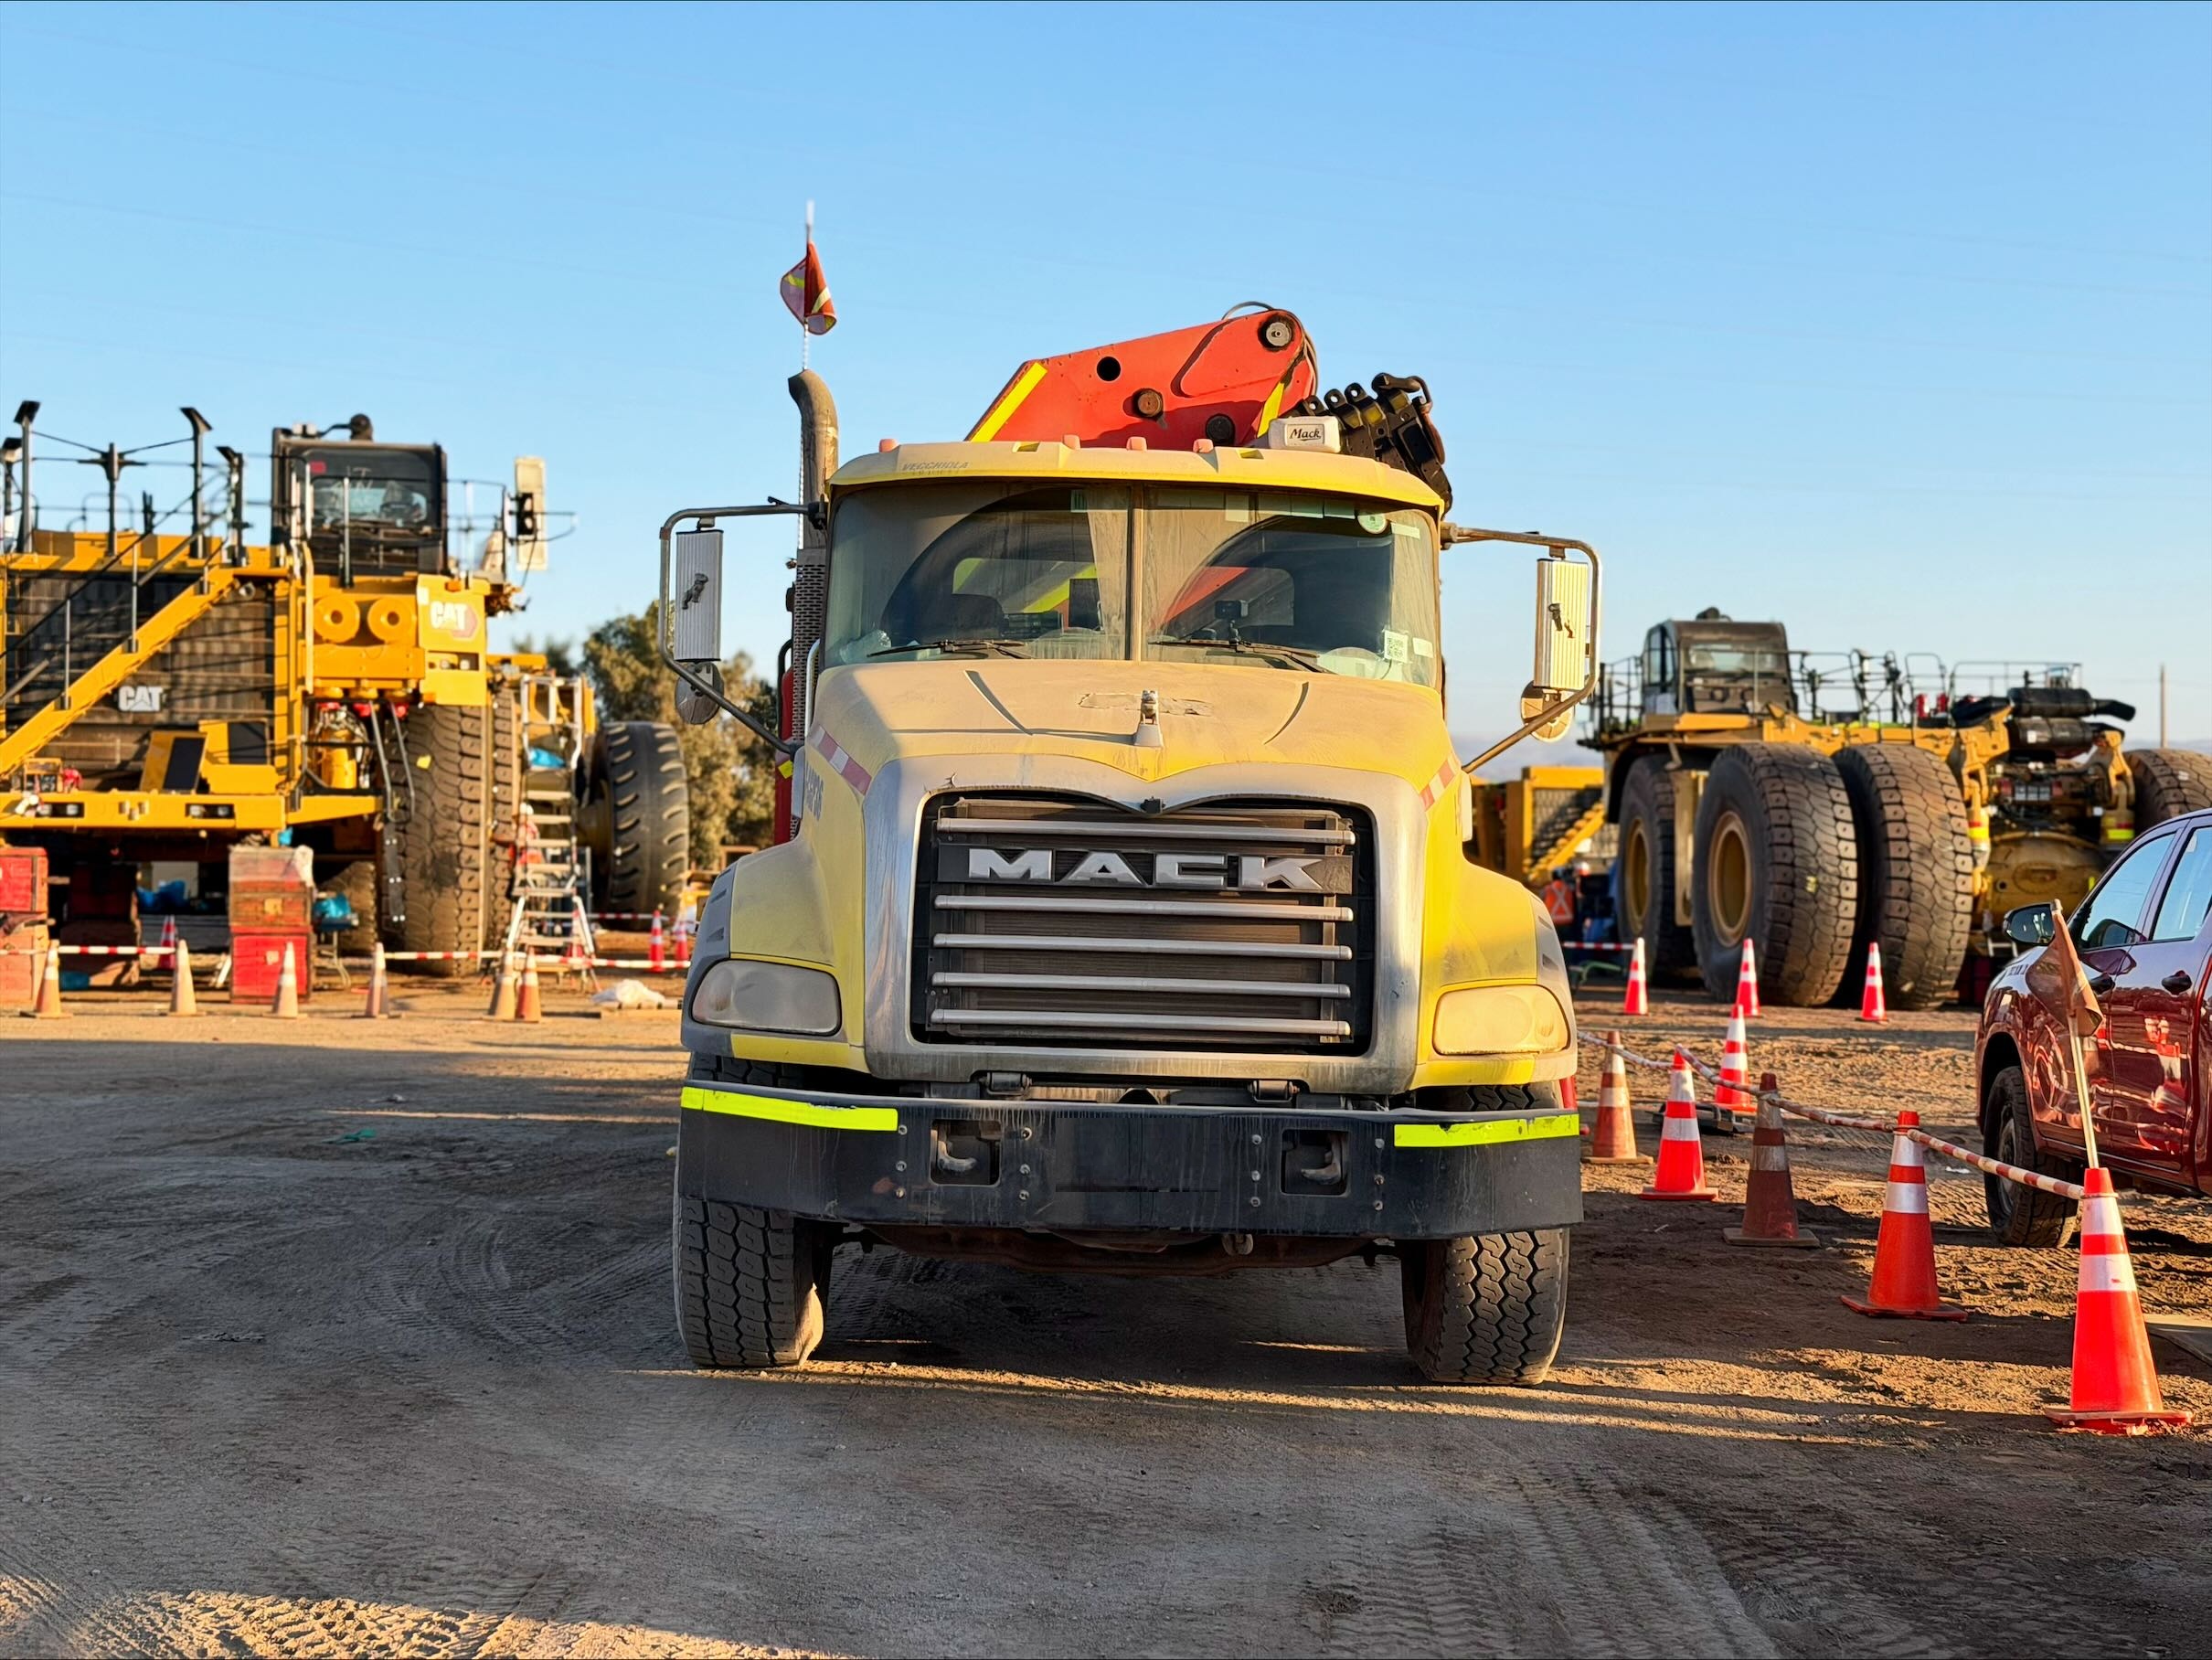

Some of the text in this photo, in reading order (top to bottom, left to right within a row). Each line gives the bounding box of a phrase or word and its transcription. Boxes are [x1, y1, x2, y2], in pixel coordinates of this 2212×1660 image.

[1290, 427, 1322, 441] Mack
[431, 601, 467, 631] CAT
[118, 686, 163, 712] CAT
[968, 847, 1324, 891] MACK
